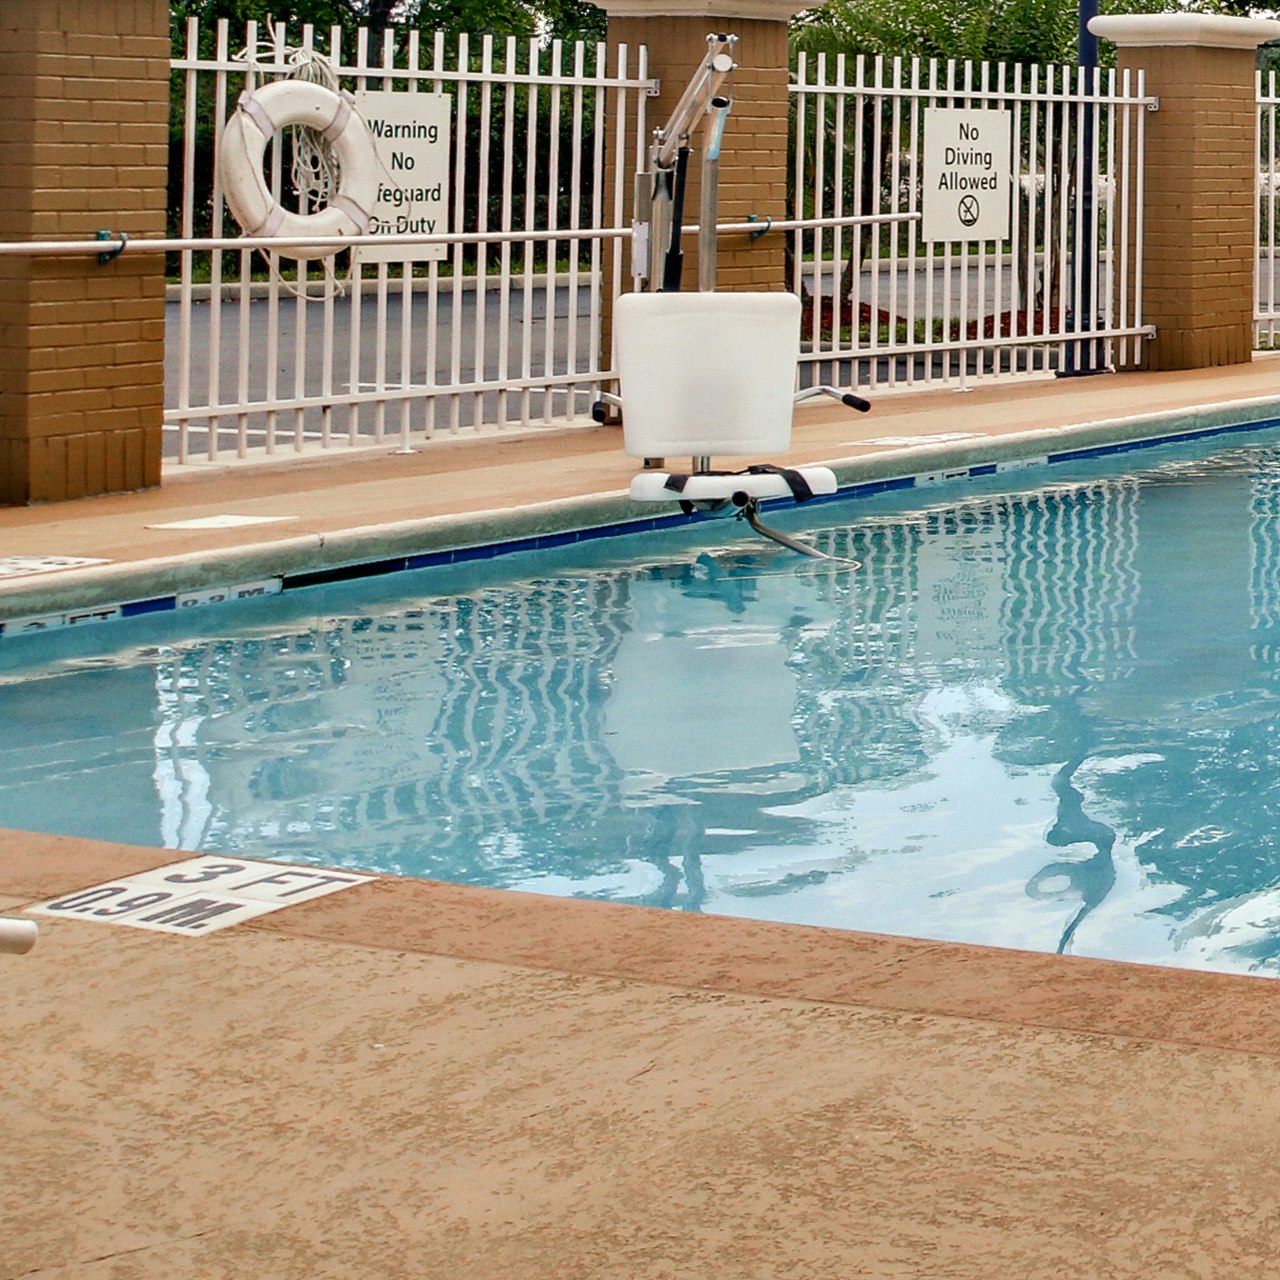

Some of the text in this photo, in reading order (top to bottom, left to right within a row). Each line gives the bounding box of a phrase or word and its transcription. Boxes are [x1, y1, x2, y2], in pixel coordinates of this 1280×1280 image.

[367, 119, 438, 143] Warning
[959, 122, 979, 141] No
[391, 151, 415, 170] No
[945, 147, 992, 170] Diving
[938, 172, 998, 190] Allowed
[377, 182, 441, 207] feguard
[369, 215, 436, 235] On Duty
[163, 864, 360, 898] 3 FT
[46, 886, 174, 917] 0.9
